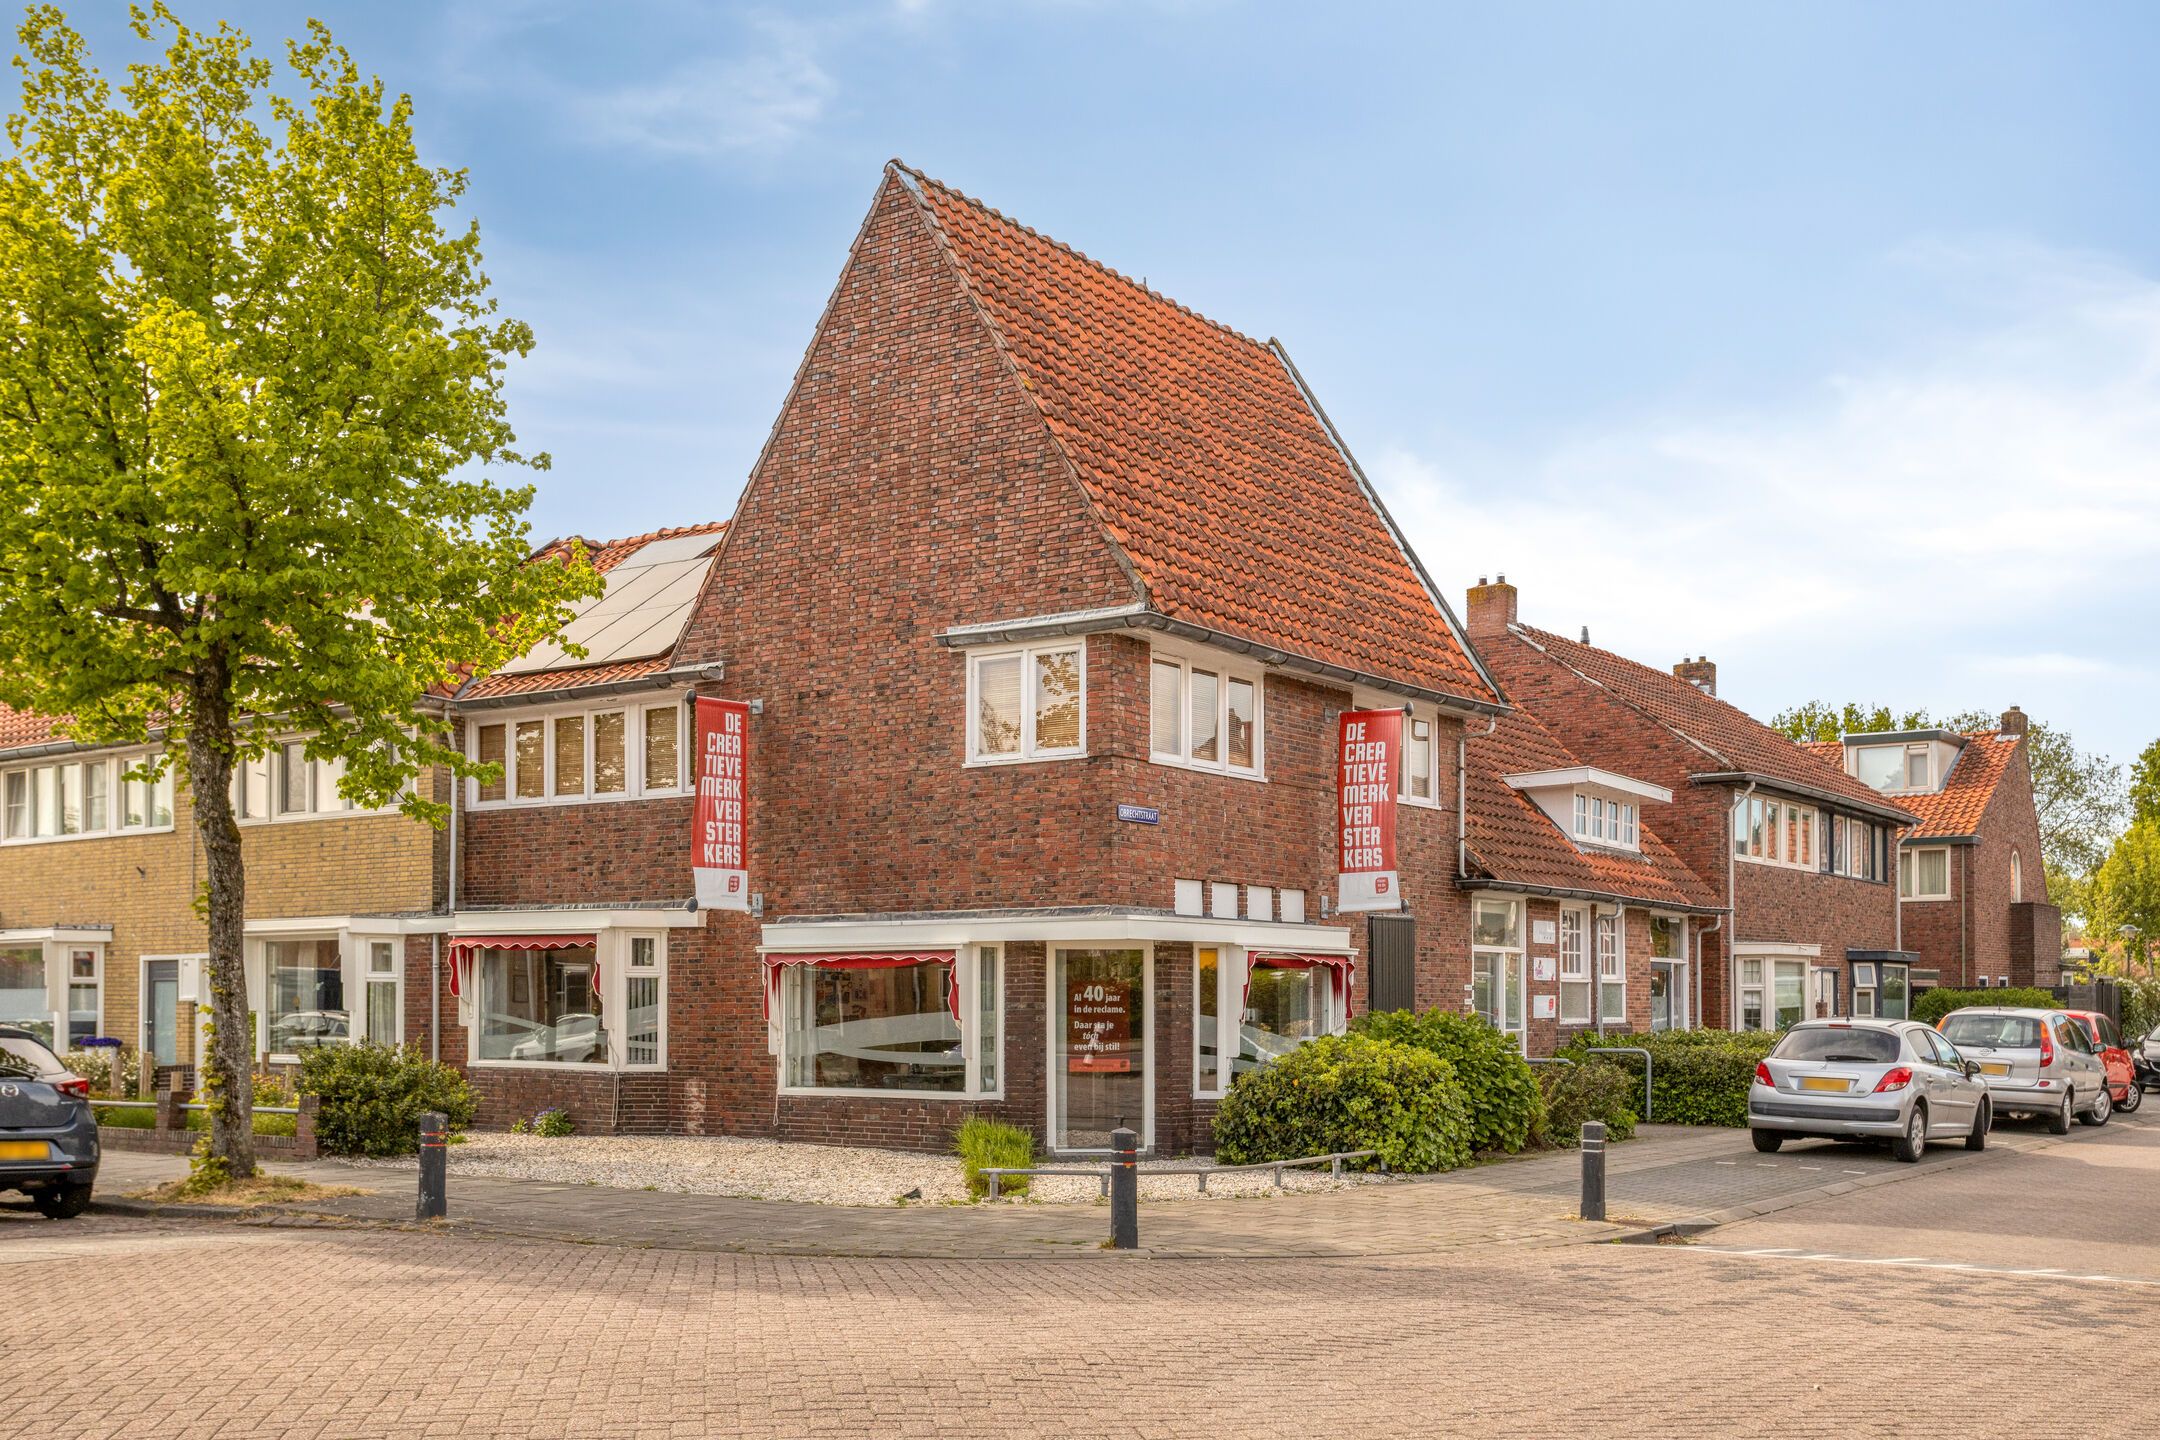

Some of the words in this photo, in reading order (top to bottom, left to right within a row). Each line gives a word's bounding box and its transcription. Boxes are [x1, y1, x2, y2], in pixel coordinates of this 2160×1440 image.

[725, 712, 742, 733] DE
[1345, 722, 1366, 742] DE
[707, 732, 741, 755] CREA
[1345, 741, 1386, 763] CREA
[704, 754, 742, 778] TIEVE
[1343, 762, 1388, 784] TIEVE
[701, 776, 742, 800] MERK
[1343, 783, 1390, 805] MERK
[715, 799, 741, 821] VER
[1119, 808, 1158, 821] OBRECHTSTRAAT
[1343, 805, 1372, 826] VER
[706, 821, 741, 843] STER
[1343, 826, 1381, 847] STER
[704, 843, 741, 865] KERS
[1344, 847, 1383, 868] KERS
[1083, 985, 1104, 1002] 40
[1105, 993, 1121, 1004] jaar
[1074, 1005, 1082, 1014] in
[1083, 1005, 1092, 1014] de
[1093, 1005, 1126, 1014] reclame.
[1074, 1021, 1092, 1029] Daar
[1105, 1021, 1114, 1031] je
[1093, 1042, 1104, 1053] bij
[1105, 1042, 1120, 1051] stil!
